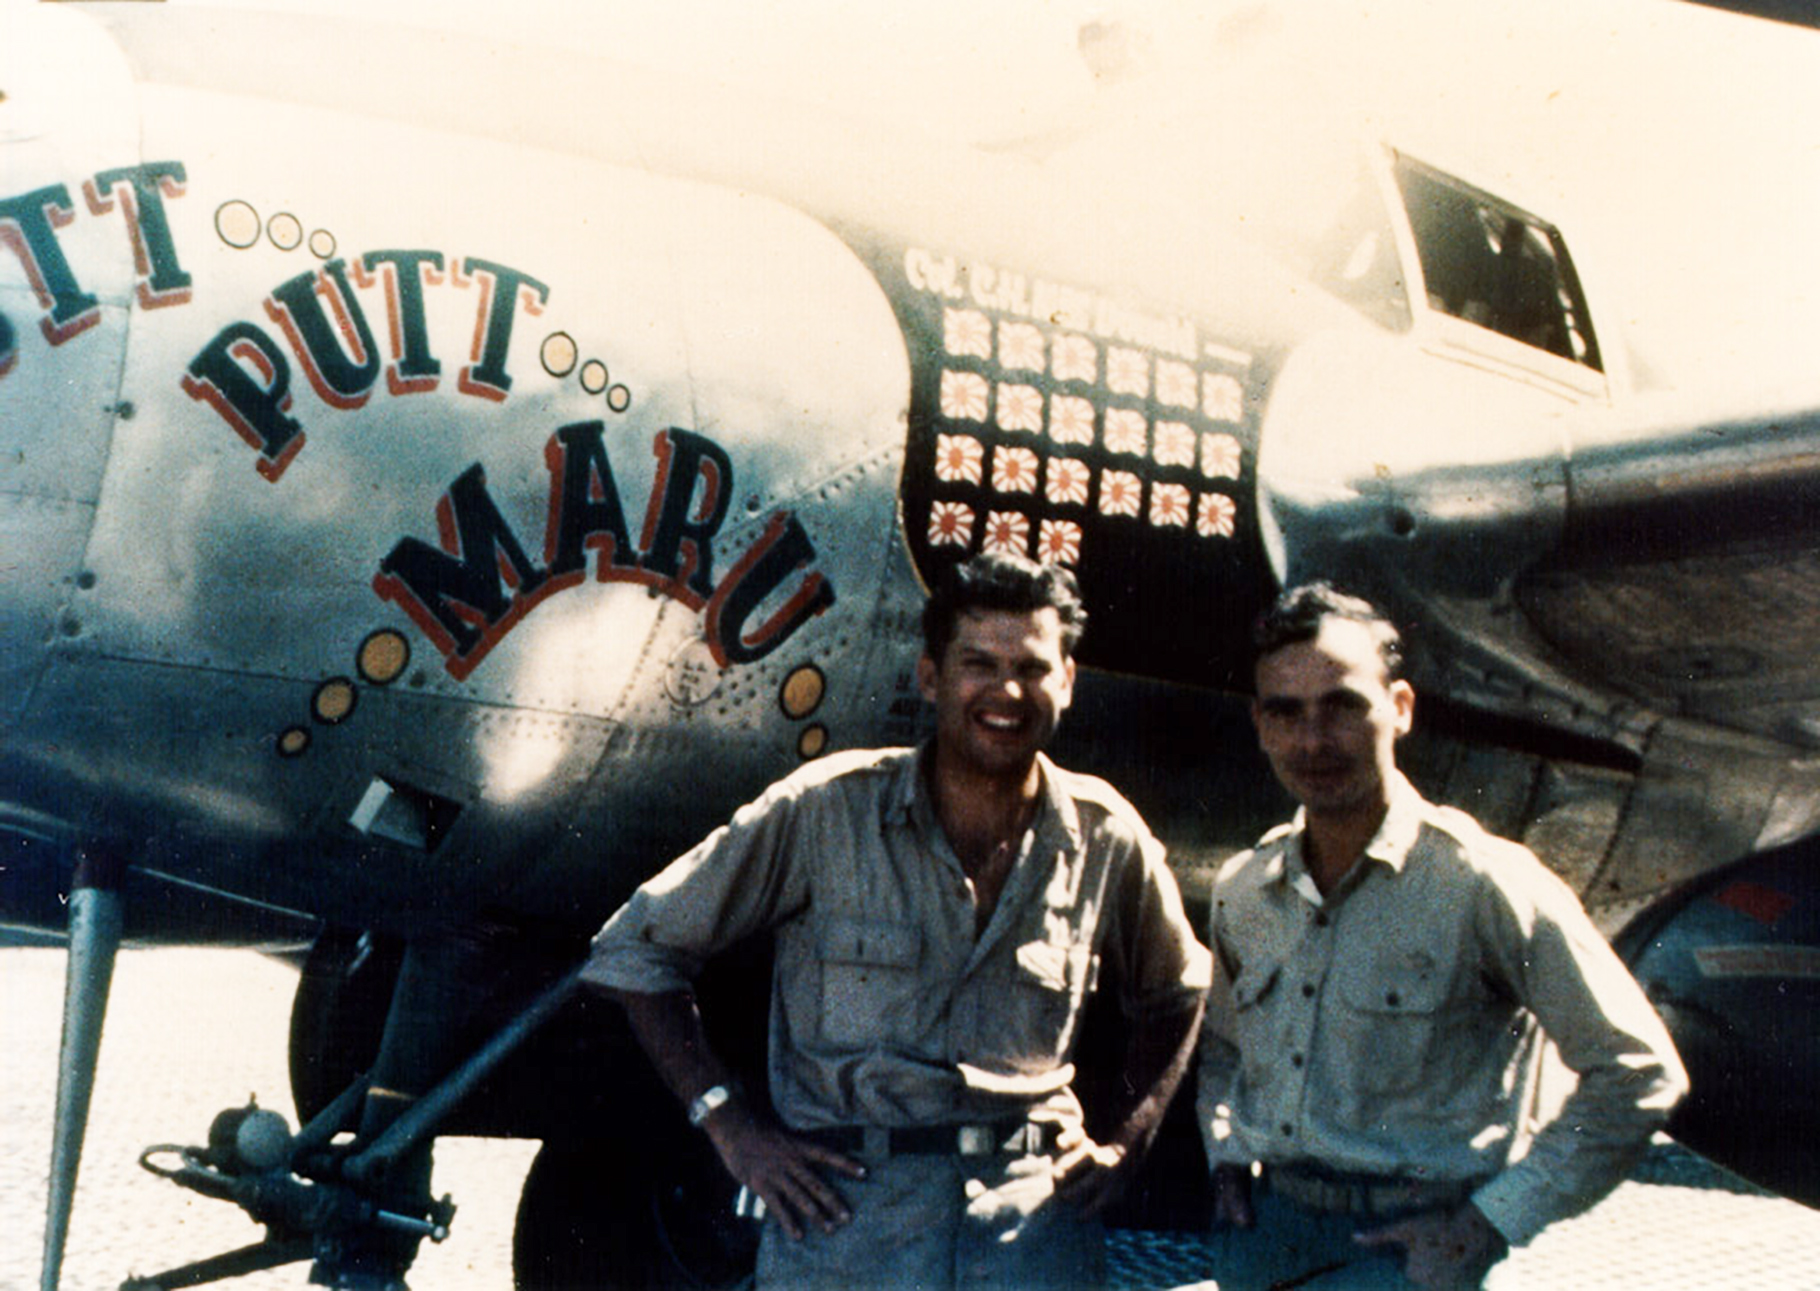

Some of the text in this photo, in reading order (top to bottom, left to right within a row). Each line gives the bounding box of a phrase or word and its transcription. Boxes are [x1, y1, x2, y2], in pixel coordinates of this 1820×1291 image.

[0, 160, 192, 382] TT
[181, 249, 550, 483] PUTT
[372, 419, 837, 682] MARU
